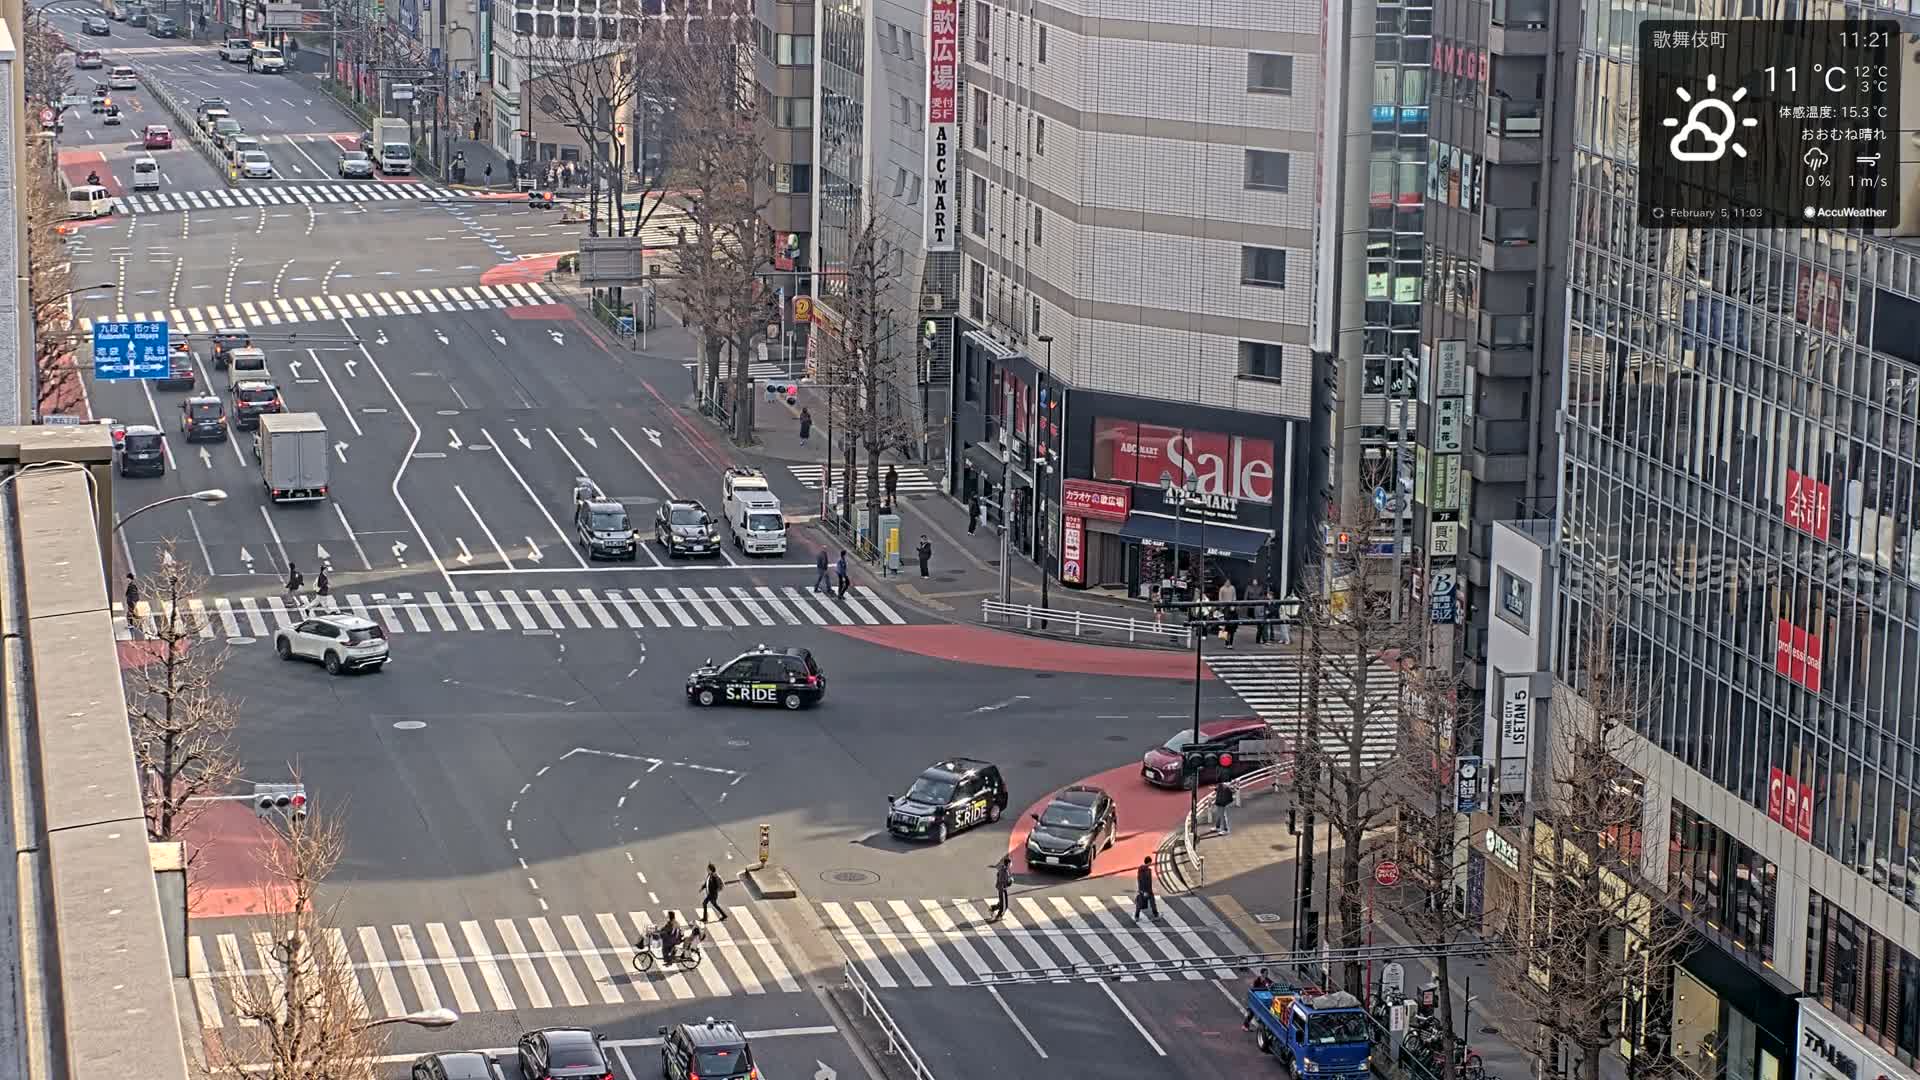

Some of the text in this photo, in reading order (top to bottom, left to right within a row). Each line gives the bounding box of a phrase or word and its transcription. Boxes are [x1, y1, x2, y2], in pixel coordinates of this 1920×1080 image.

[932, 9, 955, 91] 歌広場
[1432, 40, 1487, 81] AMIGO
[931, 97, 953, 109] 受付
[931, 109, 953, 119] 5F
[100, 323, 129, 333] 九段下
[1167, 434, 1273, 503] Sale
[1065, 490, 1091, 502] カラオケ
[1790, 481, 1826, 529] 会計
[1435, 525, 1448, 552] 買取
[726, 687, 777, 701] S.RIDE
[1504, 700, 1513, 738] PARK CITY
[1513, 689, 1527, 745] ISETAN 5
[955, 805, 987, 829] S.RIDE
[1771, 778, 1810, 828] CPA
